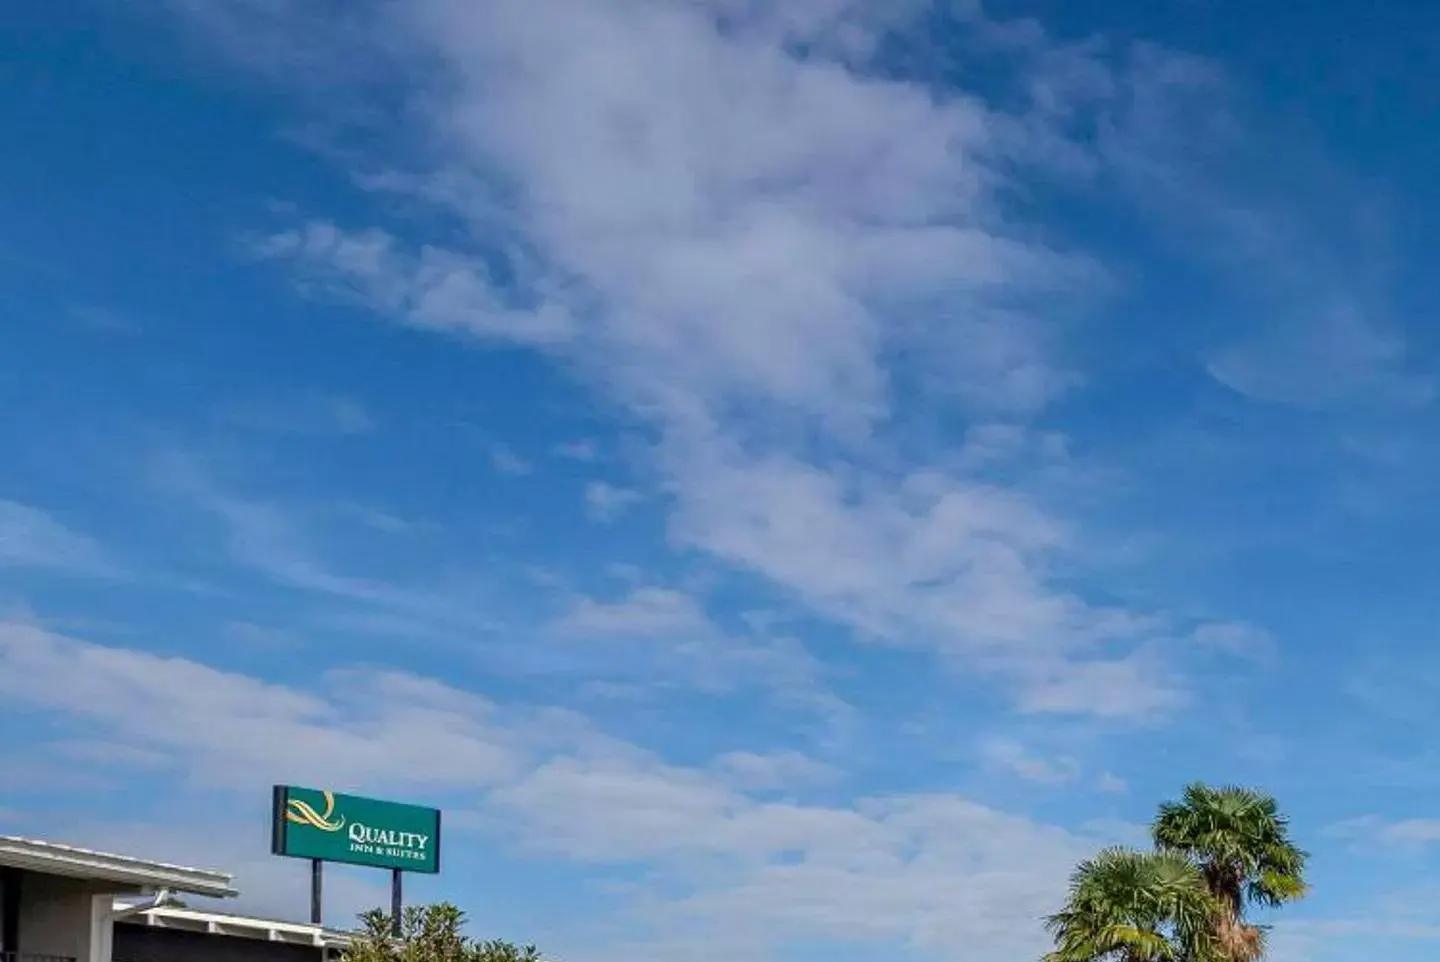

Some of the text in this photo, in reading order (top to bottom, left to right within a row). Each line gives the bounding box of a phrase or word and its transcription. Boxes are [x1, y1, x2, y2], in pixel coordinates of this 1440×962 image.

[349, 823, 428, 849] QUALITY
[350, 843, 426, 860] INN & SUITES
